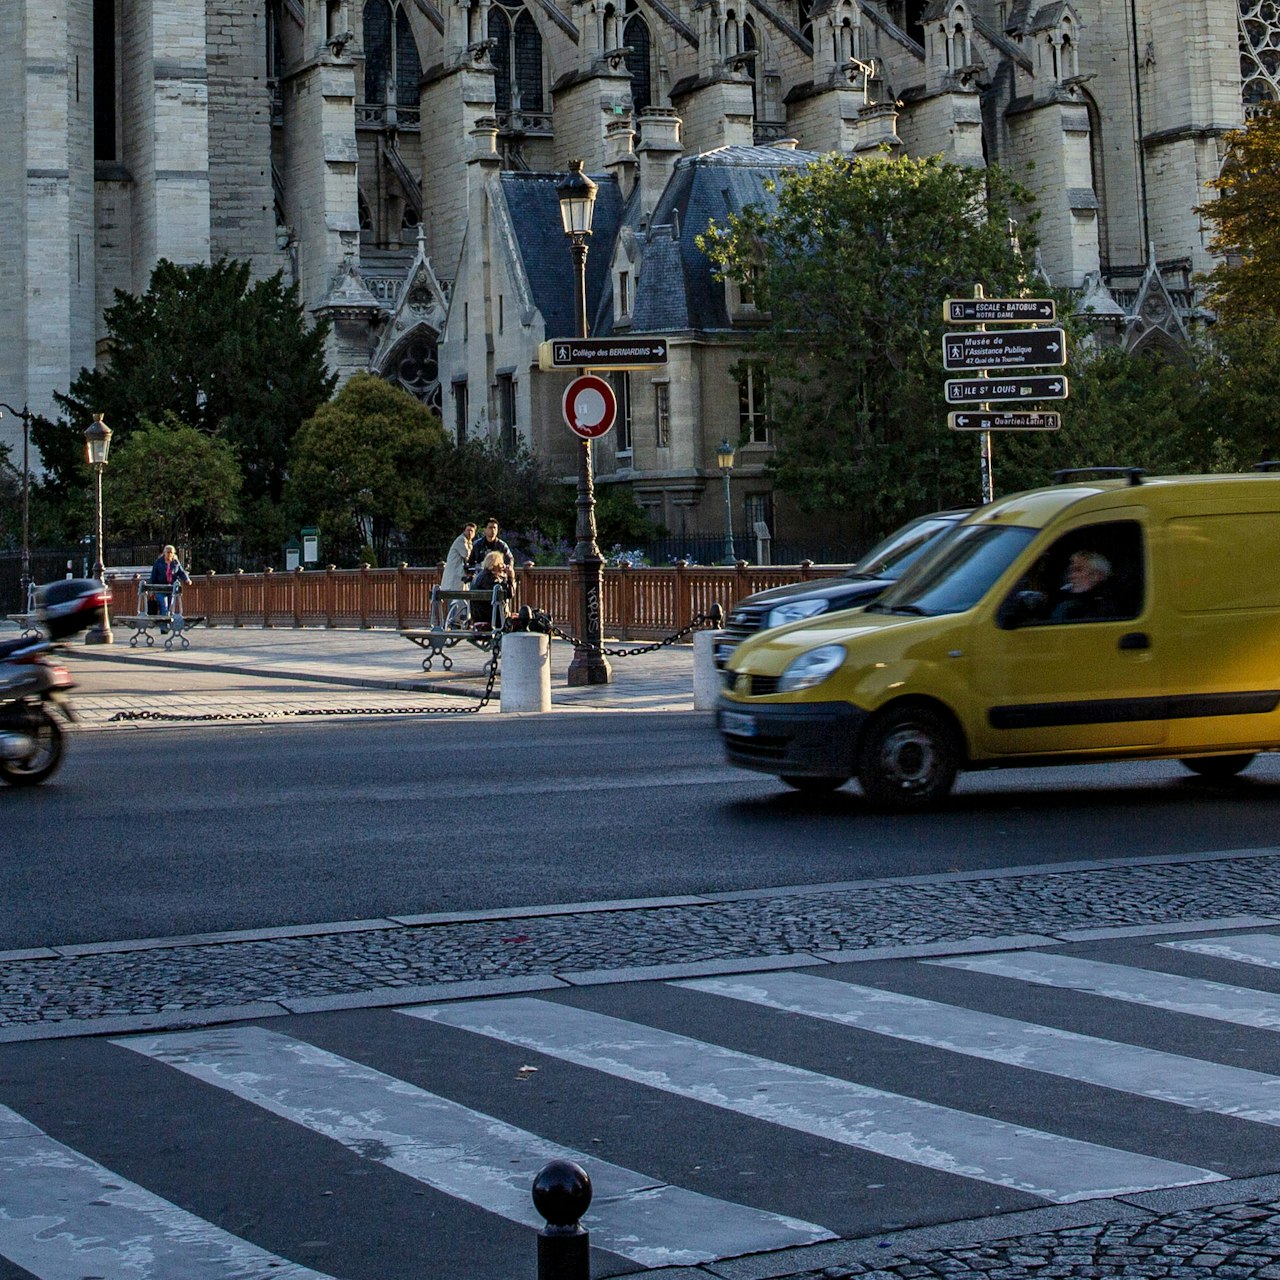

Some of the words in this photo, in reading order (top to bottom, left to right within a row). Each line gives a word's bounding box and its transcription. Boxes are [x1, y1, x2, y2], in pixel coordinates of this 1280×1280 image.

[975, 303, 1000, 311] ESCALE
[1006, 303, 1037, 311] BATOBUS
[964, 337, 991, 346] Musée
[993, 337, 1003, 345] de
[572, 349, 596, 358] Collège
[609, 348, 651, 356] BERNARDINS
[965, 347, 1004, 356] l'Assistance
[1004, 345, 1032, 355] Publique
[992, 385, 1016, 394] LOUIS
[1026, 417, 1044, 425] Latin
